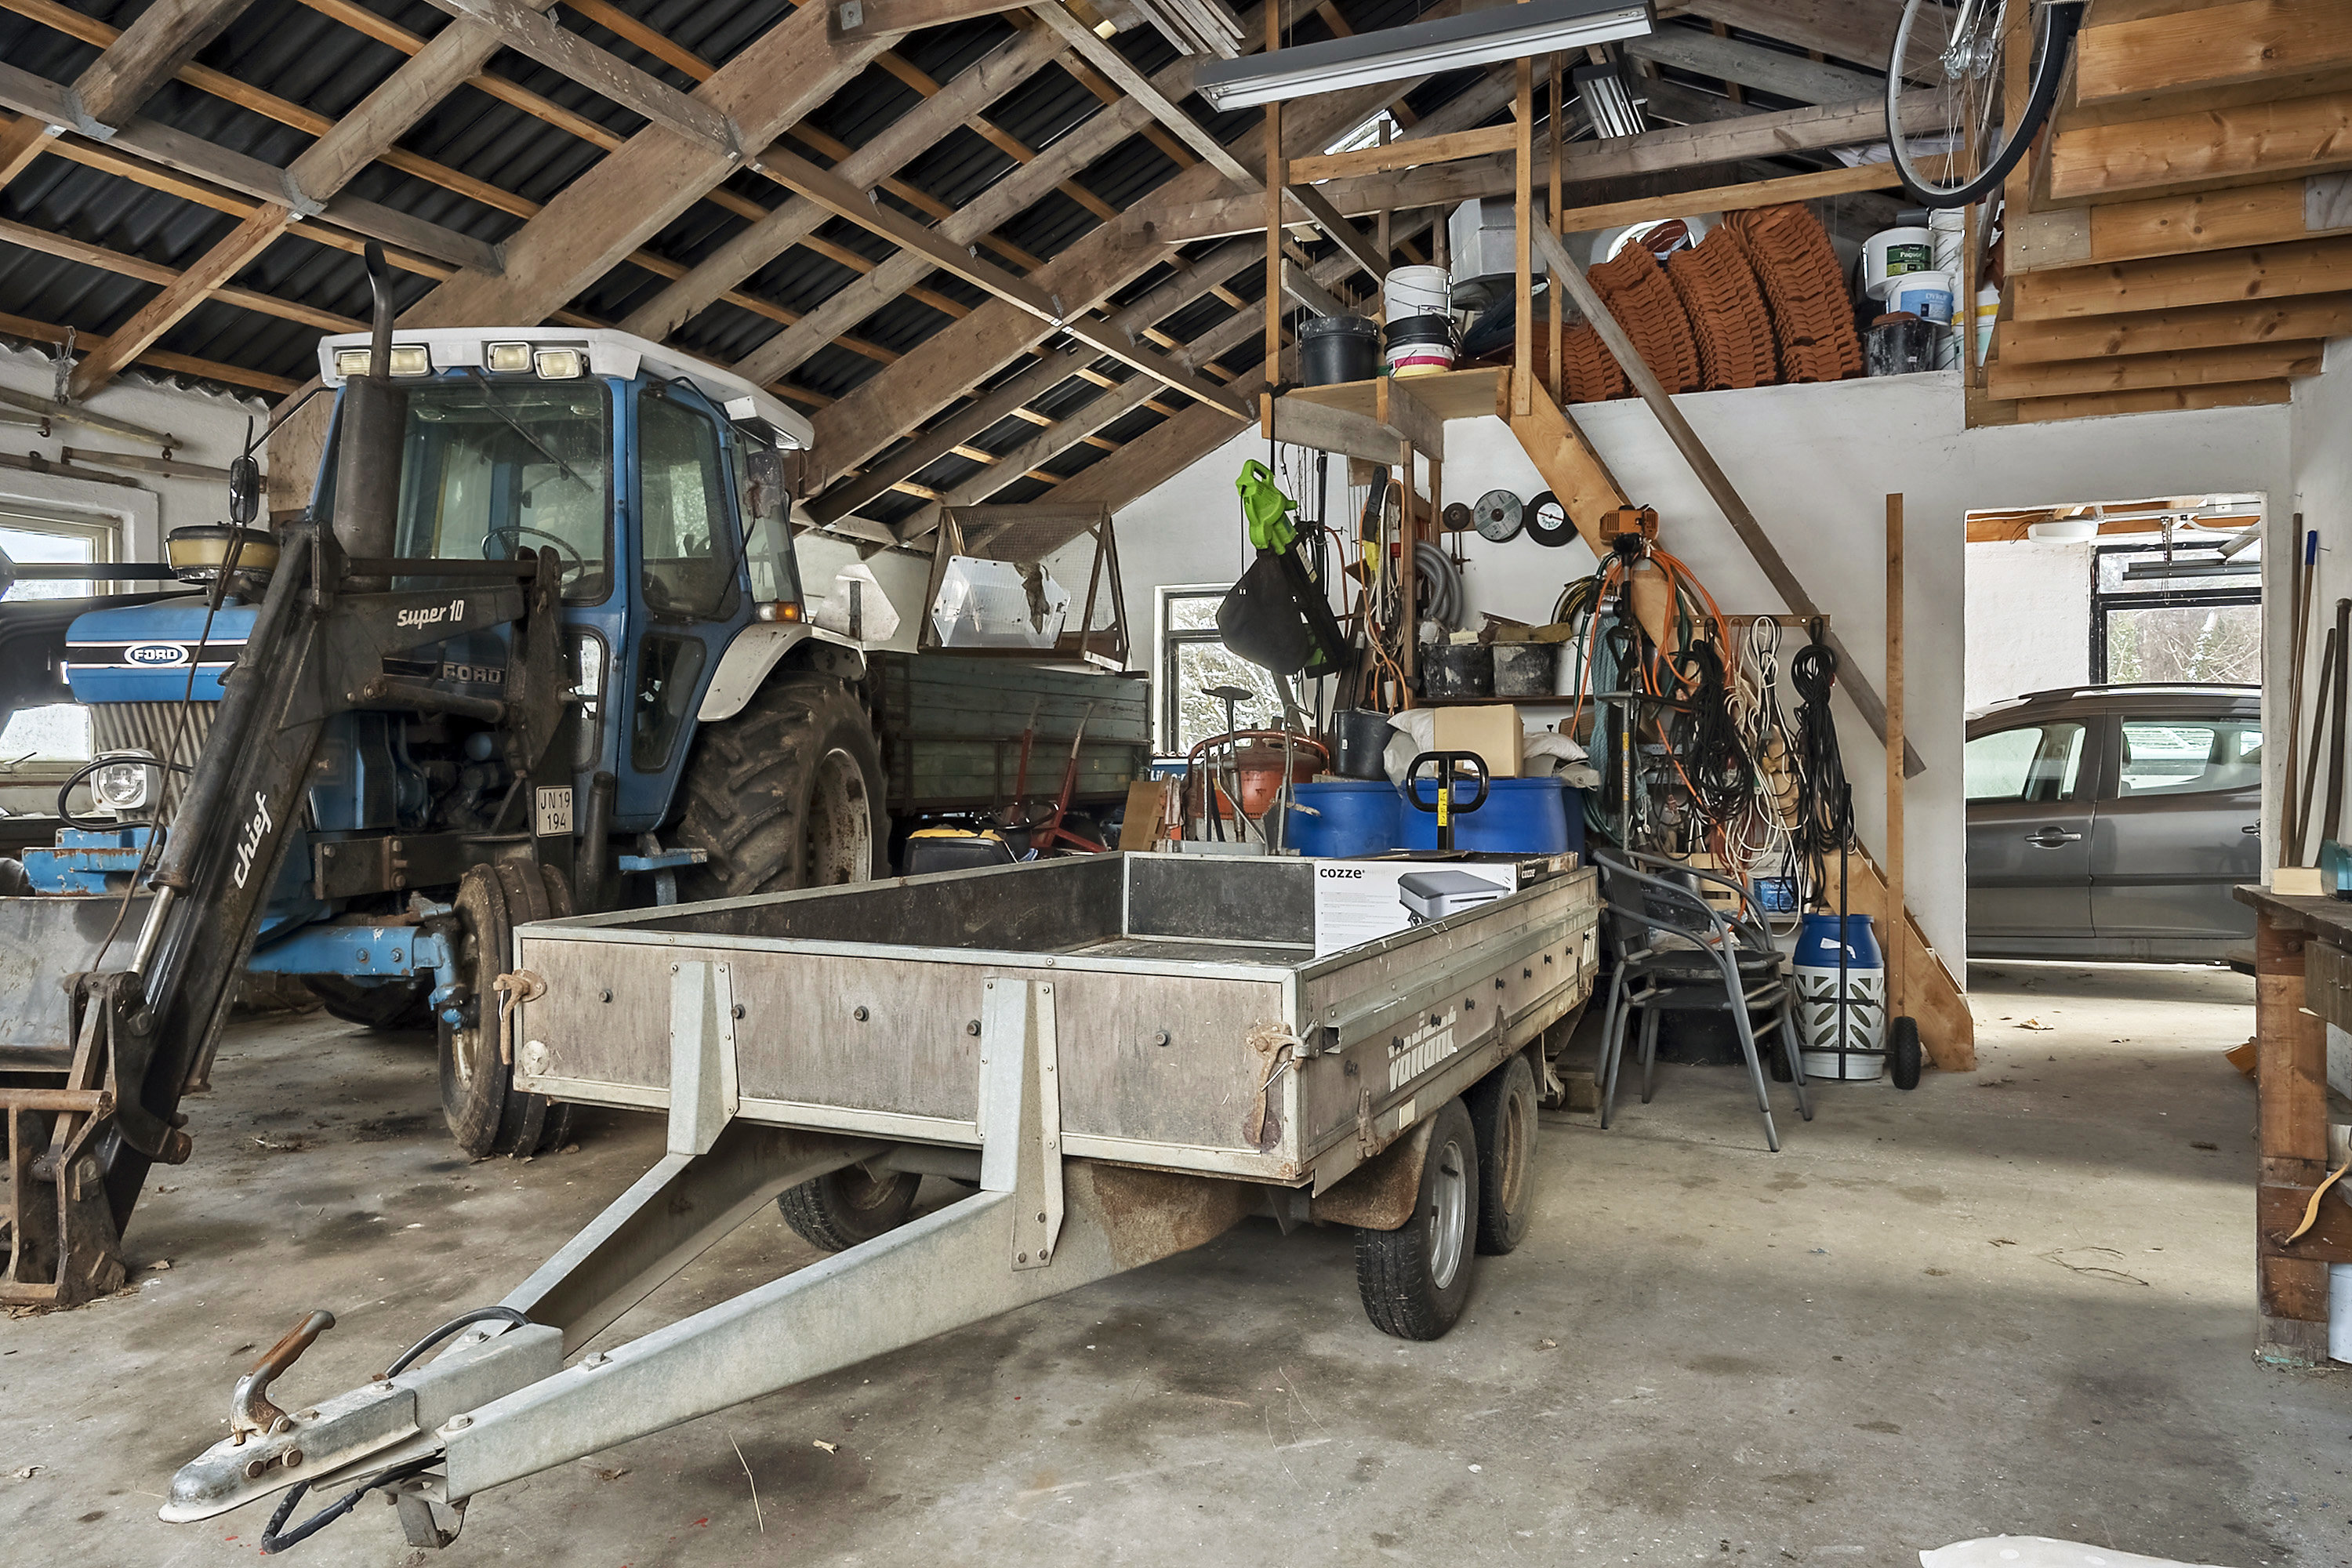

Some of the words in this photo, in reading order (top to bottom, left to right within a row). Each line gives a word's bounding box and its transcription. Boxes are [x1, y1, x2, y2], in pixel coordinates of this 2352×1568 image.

[397, 606, 447, 630] super
[449, 600, 465, 622] 10
[134, 648, 179, 660] FORD
[443, 664, 503, 684] FORD
[540, 792, 556, 809] JN
[559, 791, 570, 808] 19
[547, 812, 566, 830] 194
[234, 791, 272, 889] chief
